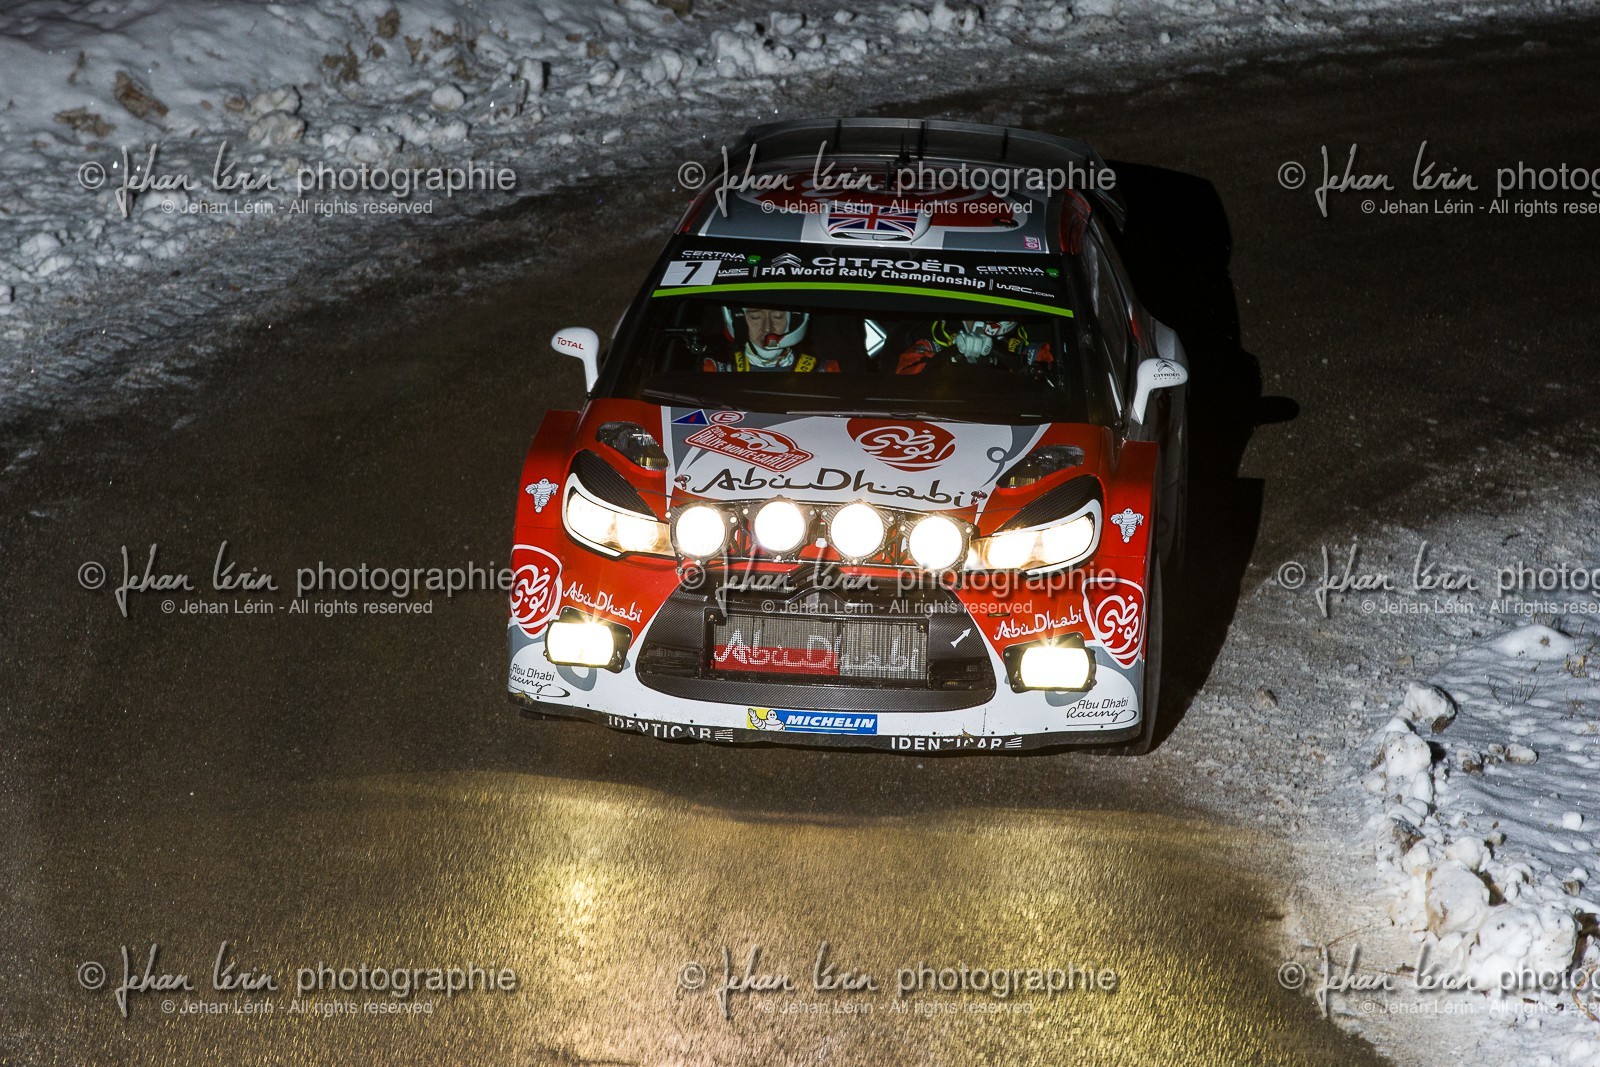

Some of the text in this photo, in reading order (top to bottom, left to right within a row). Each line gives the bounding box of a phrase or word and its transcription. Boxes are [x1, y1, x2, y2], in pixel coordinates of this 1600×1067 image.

[682, 250, 745, 259] CERTINA
[681, 262, 704, 284] 7
[976, 265, 1045, 274] CERTINA
[762, 267, 786, 276] FIA
[791, 267, 834, 276] World
[839, 268, 876, 278] Rally
[881, 270, 986, 289] Championship
[557, 336, 584, 350] TOTAL
[691, 430, 728, 449] RALLYE
[512, 663, 555, 681] Abu Dhabi
[1077, 697, 1129, 709] Abu Dhabi
[785, 715, 875, 729] MICHELIN
[1066, 706, 1126, 723] Racing
